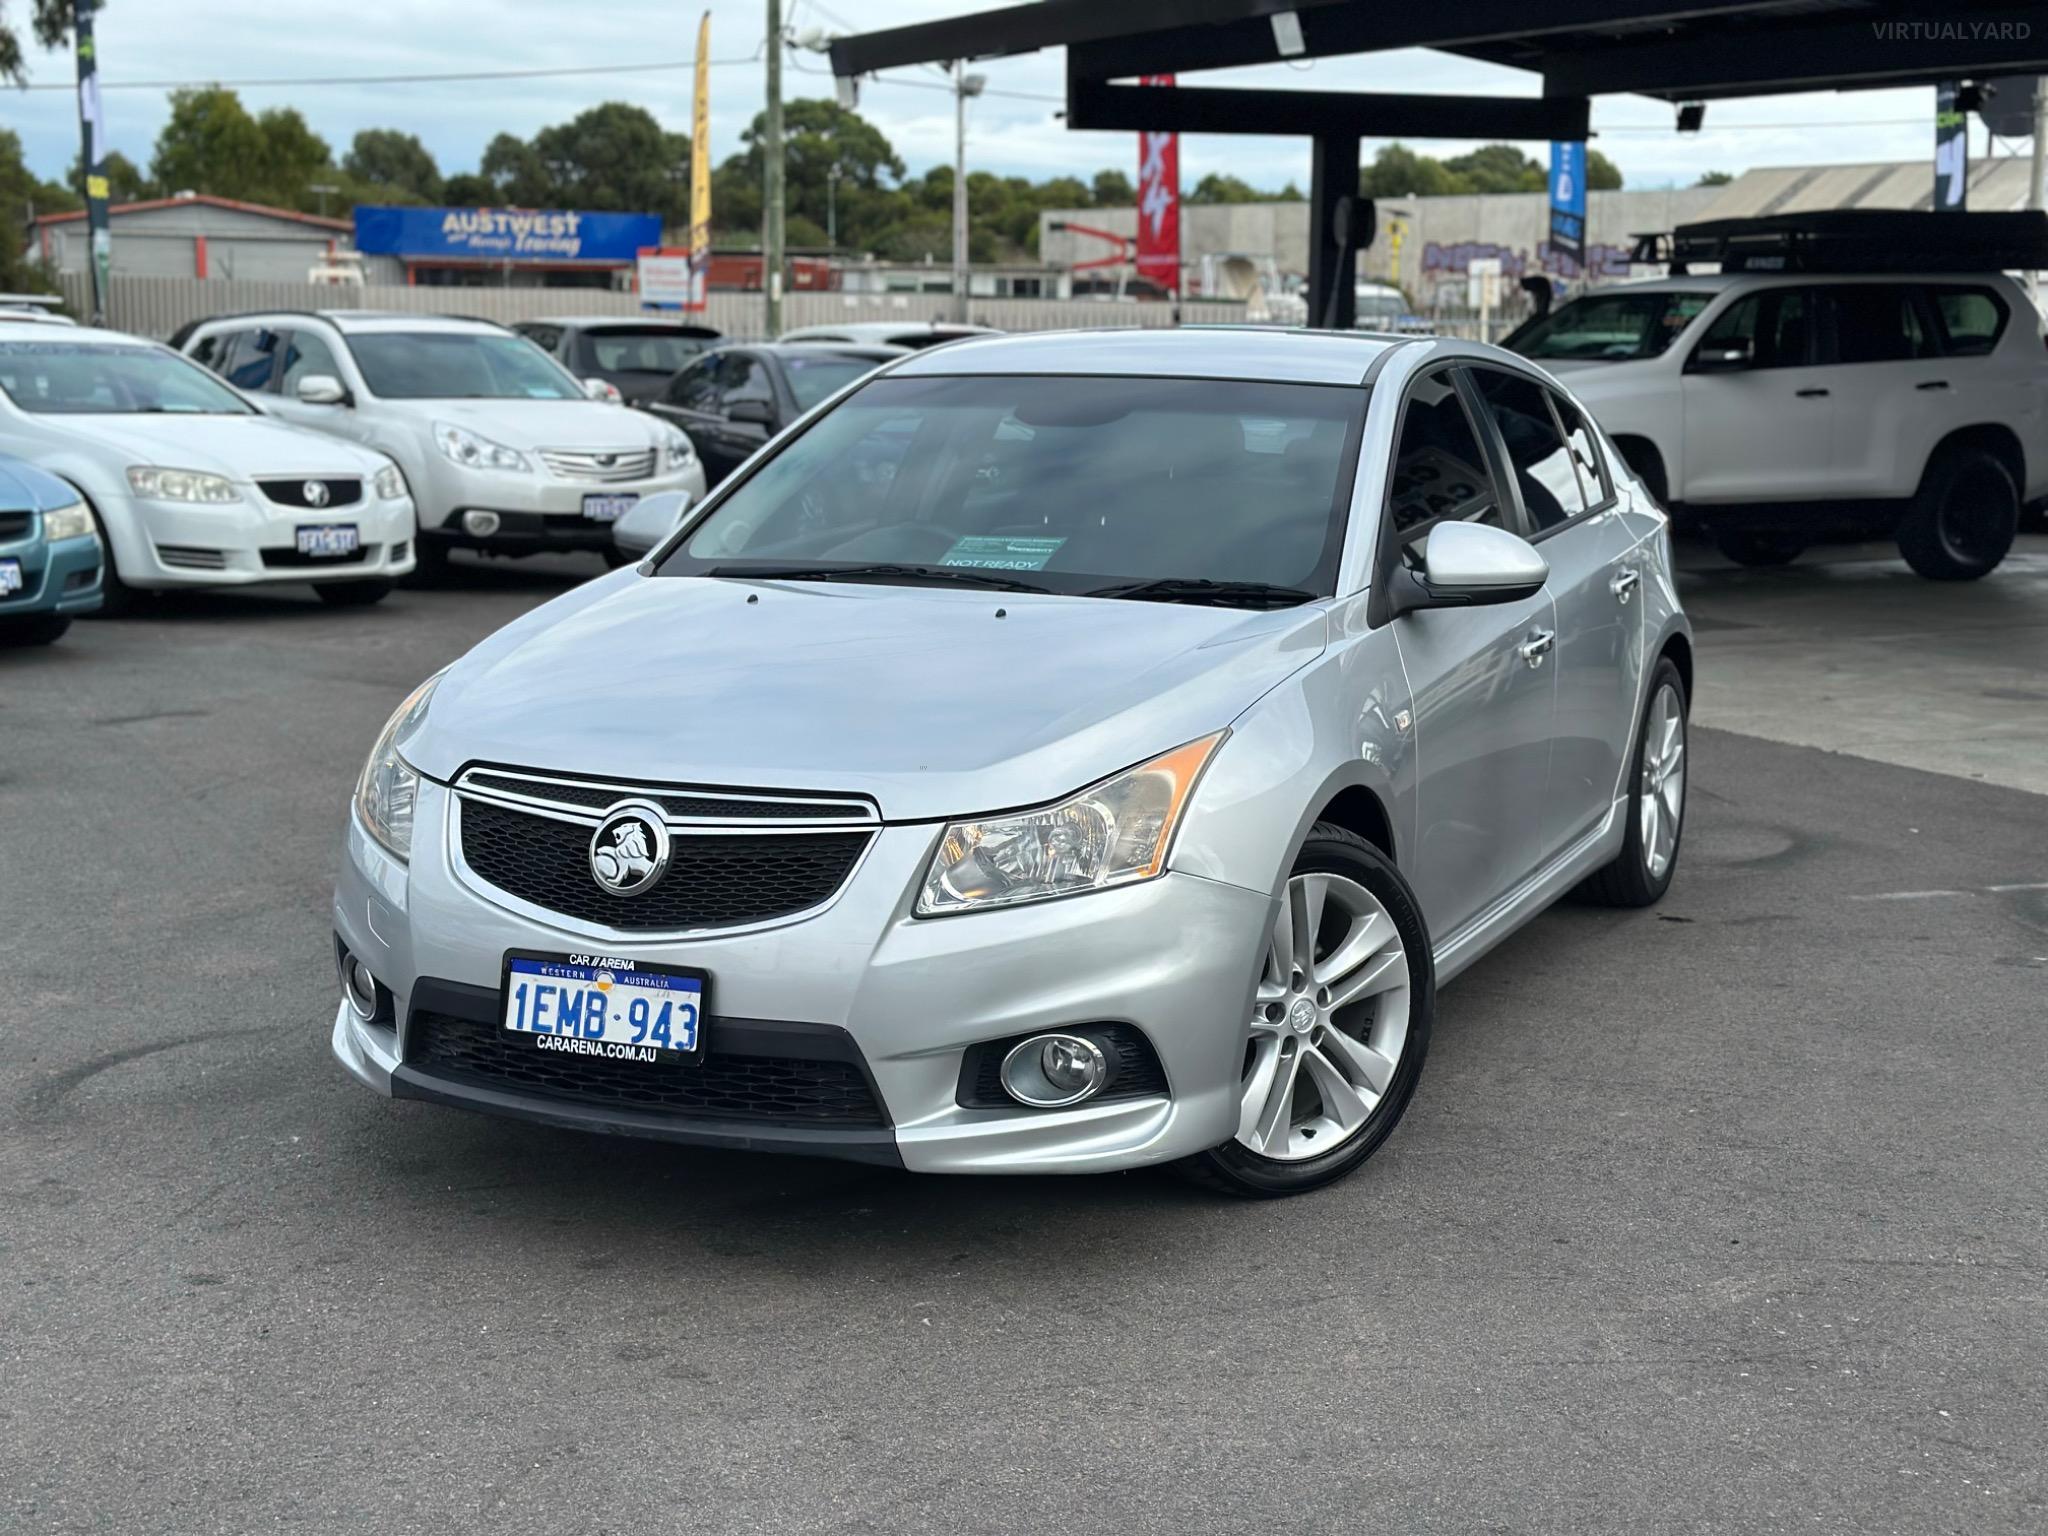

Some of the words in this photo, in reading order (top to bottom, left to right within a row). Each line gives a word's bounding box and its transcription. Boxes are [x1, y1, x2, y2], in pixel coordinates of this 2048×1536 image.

[443, 211, 581, 237] AUSTWEST
[947, 559, 982, 567] NOT
[980, 560, 1040, 569] READY
[569, 954, 590, 967] CAR
[541, 967, 585, 979] WESTERN
[624, 976, 670, 989] AUSTRALIA
[536, 1035, 657, 1063] CARARENA.COM.AU
